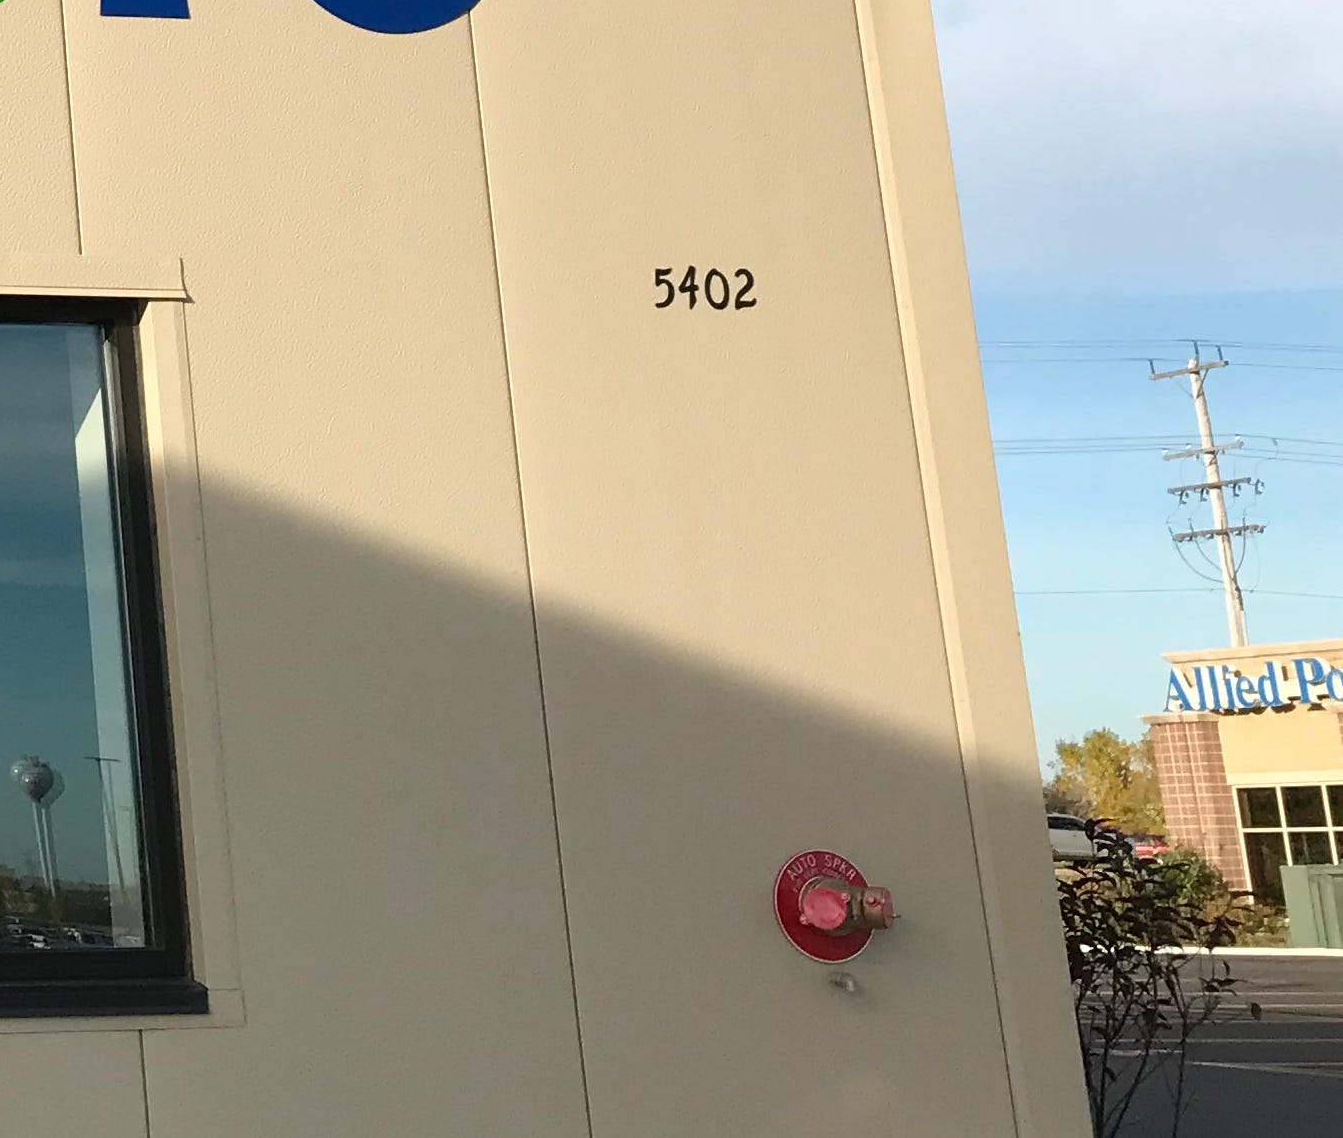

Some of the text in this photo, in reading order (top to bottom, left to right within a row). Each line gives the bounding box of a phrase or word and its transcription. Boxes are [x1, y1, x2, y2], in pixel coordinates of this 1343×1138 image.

[655, 265, 757, 310] 5402
[1163, 661, 1285, 712] Allied
[787, 854, 817, 880] AUTO
